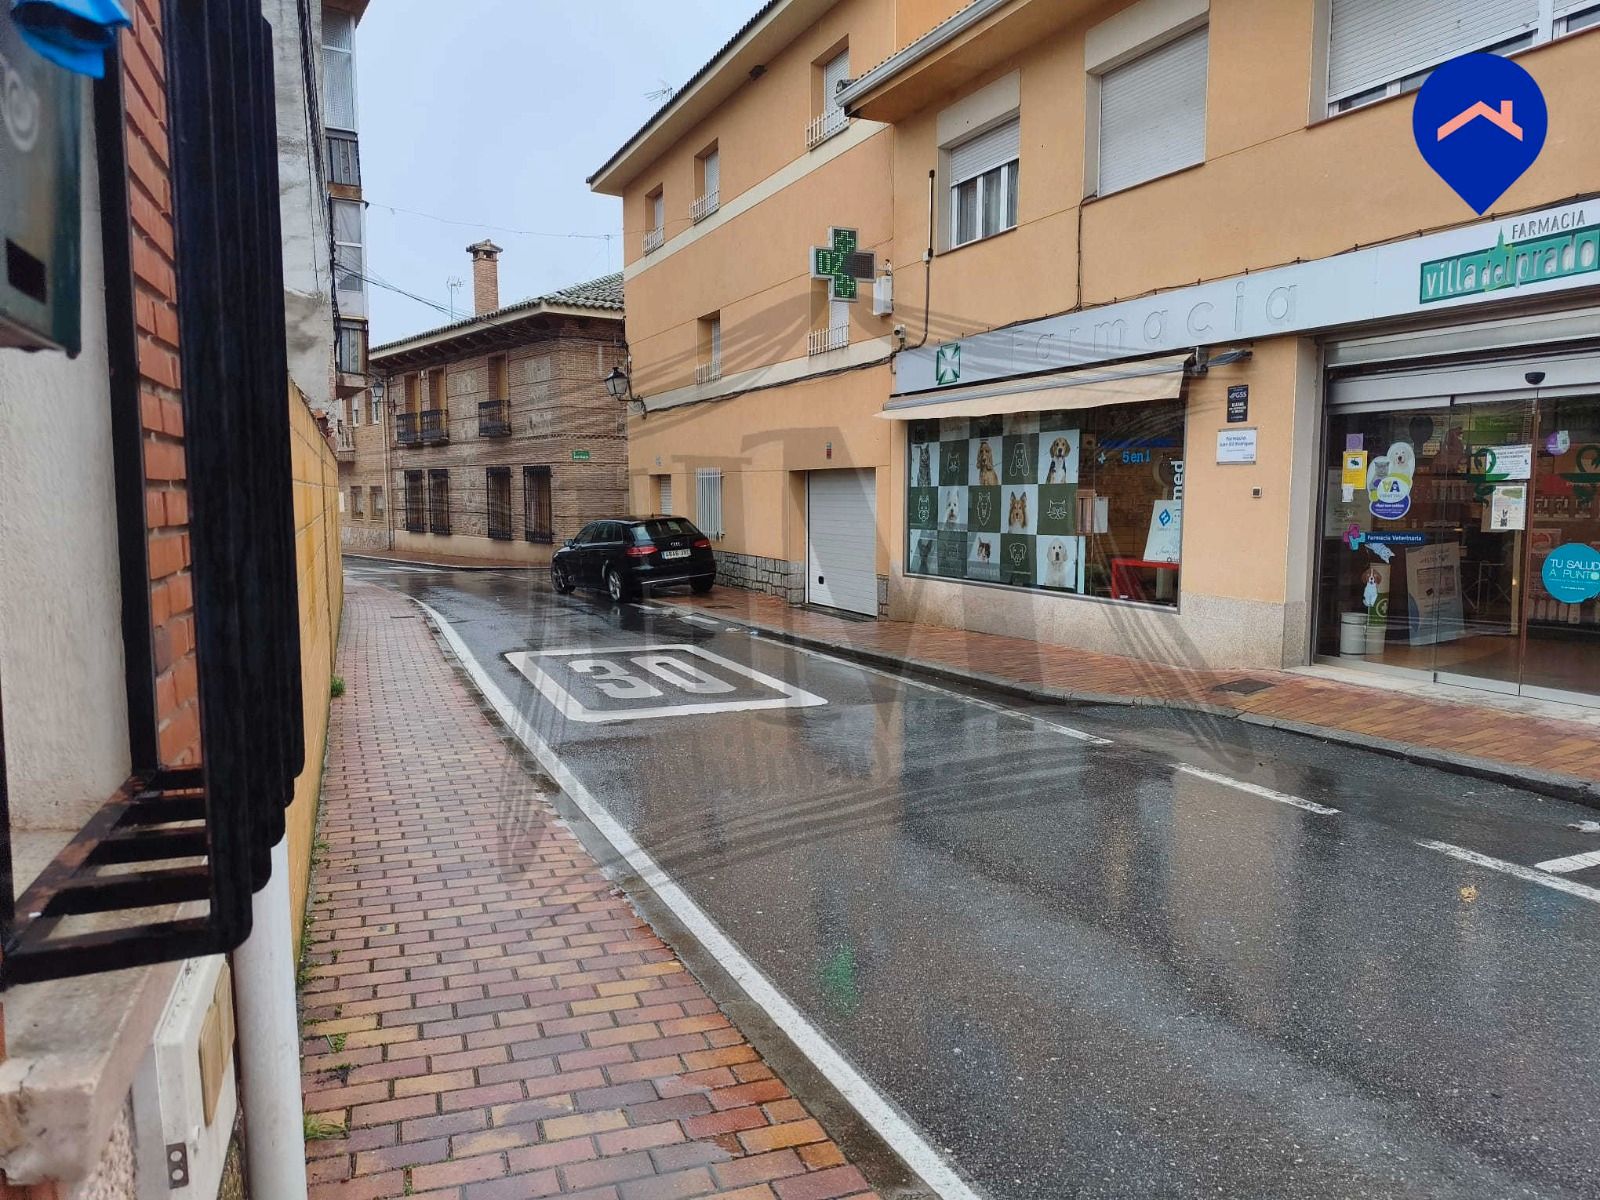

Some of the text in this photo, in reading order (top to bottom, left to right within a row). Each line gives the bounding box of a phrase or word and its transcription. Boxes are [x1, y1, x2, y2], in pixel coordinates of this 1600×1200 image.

[1512, 209, 1586, 239] FARMACIA
[1515, 234, 1596, 288] prado
[1549, 568, 1557, 577] A
[1550, 558, 1600, 571] TU SALUD
[568, 655, 737, 699] 30
